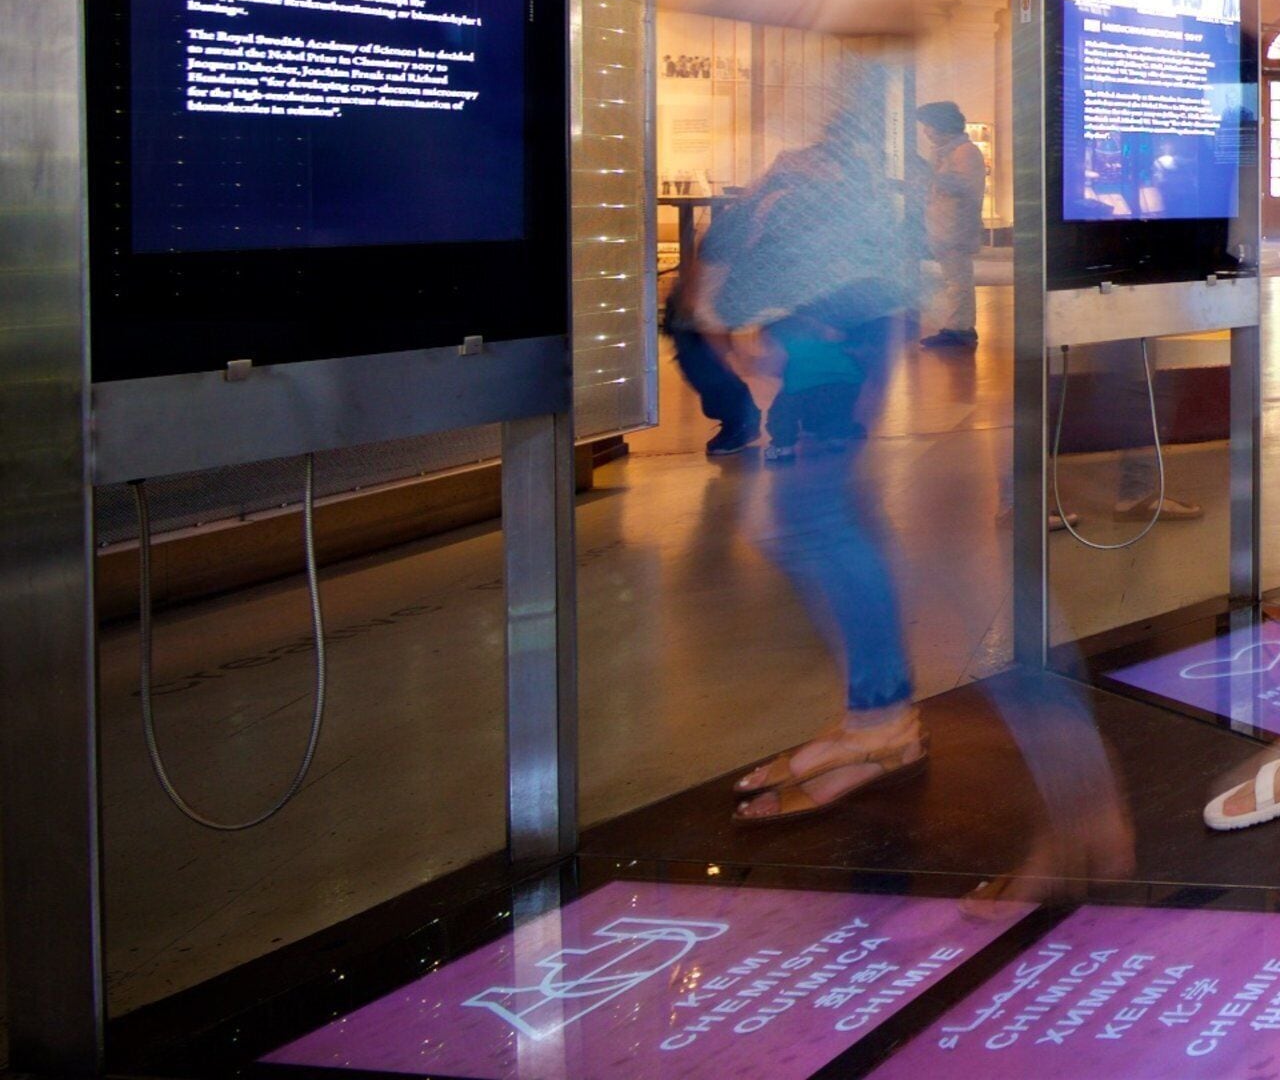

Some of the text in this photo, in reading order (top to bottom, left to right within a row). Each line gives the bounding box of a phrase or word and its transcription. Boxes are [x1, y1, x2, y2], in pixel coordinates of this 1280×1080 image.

[187, 28, 216, 41] The
[216, 30, 254, 45] Royal
[255, 33, 305, 48] Swedish
[305, 39, 359, 55] Academy
[373, 44, 417, 58] Sciences
[418, 47, 436, 59] has
[436, 49, 475, 62] decided
[204, 46, 245, 58] award
[245, 47, 267, 59] the
[267, 49, 306, 62] Nobel
[306, 52, 338, 64] Prize
[351, 56, 411, 72] Chemistry
[411, 63, 436, 74] 2017
[186, 58, 449, 85] Jacques Dubochet, Joachim Frank and Richard
[187, 72, 260, 87] Henderson
[286, 77, 350, 94] developing
[187, 85, 209, 97] for
[209, 87, 232, 98] the
[187, 99, 270, 115] biomolecules
[659, 916, 870, 1051] CHEMISTRY
[673, 949, 782, 1008] KEMI
[733, 936, 891, 1034] QUÍMICA
[813, 960, 900, 1009] 화학
[834, 945, 965, 1032] CHIMIE
[984, 948, 1119, 1051] CHIMICA
[1034, 953, 1156, 1046] ХИМИЯ
[1095, 963, 1195, 1041] KEMIA
[1157, 977, 1221, 1028] 化学
